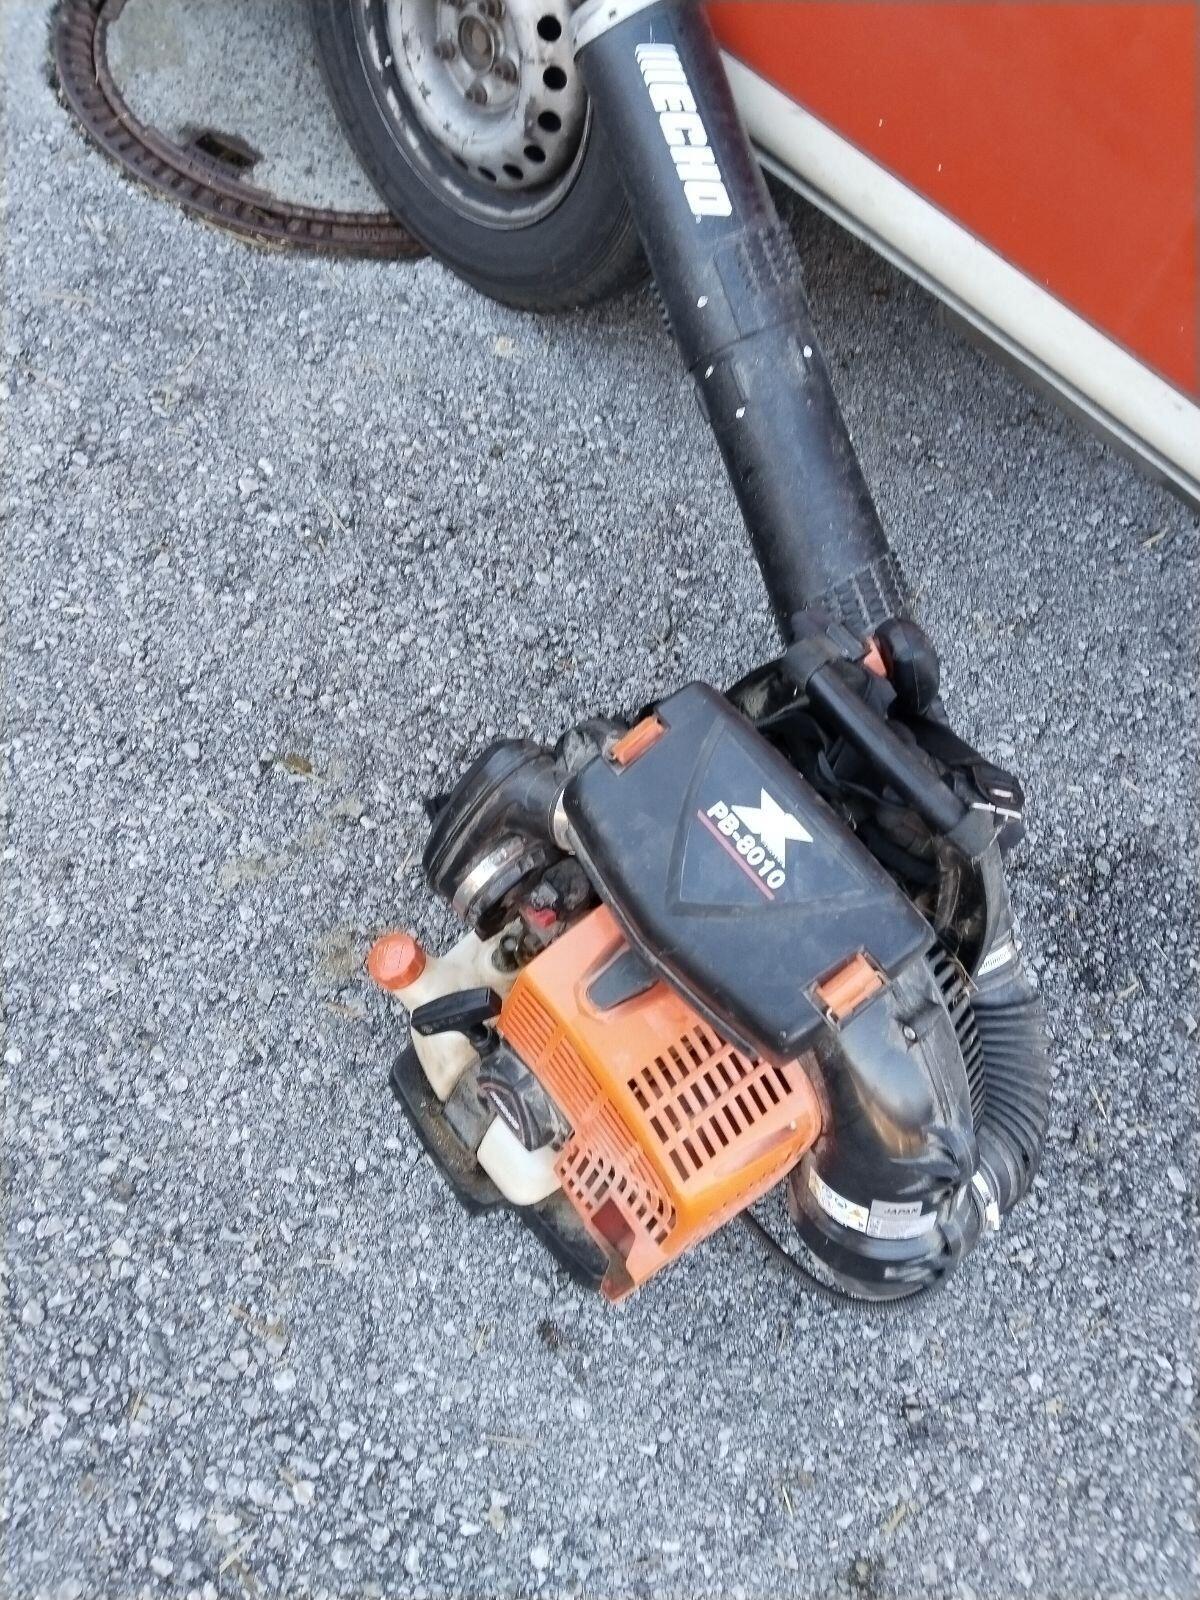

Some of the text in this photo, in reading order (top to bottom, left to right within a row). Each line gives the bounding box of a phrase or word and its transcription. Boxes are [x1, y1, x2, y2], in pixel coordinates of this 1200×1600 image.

[648, 81, 733, 217] ECHO
[706, 799, 786, 890] PB-8010
[883, 1206, 919, 1216] JAPAN
